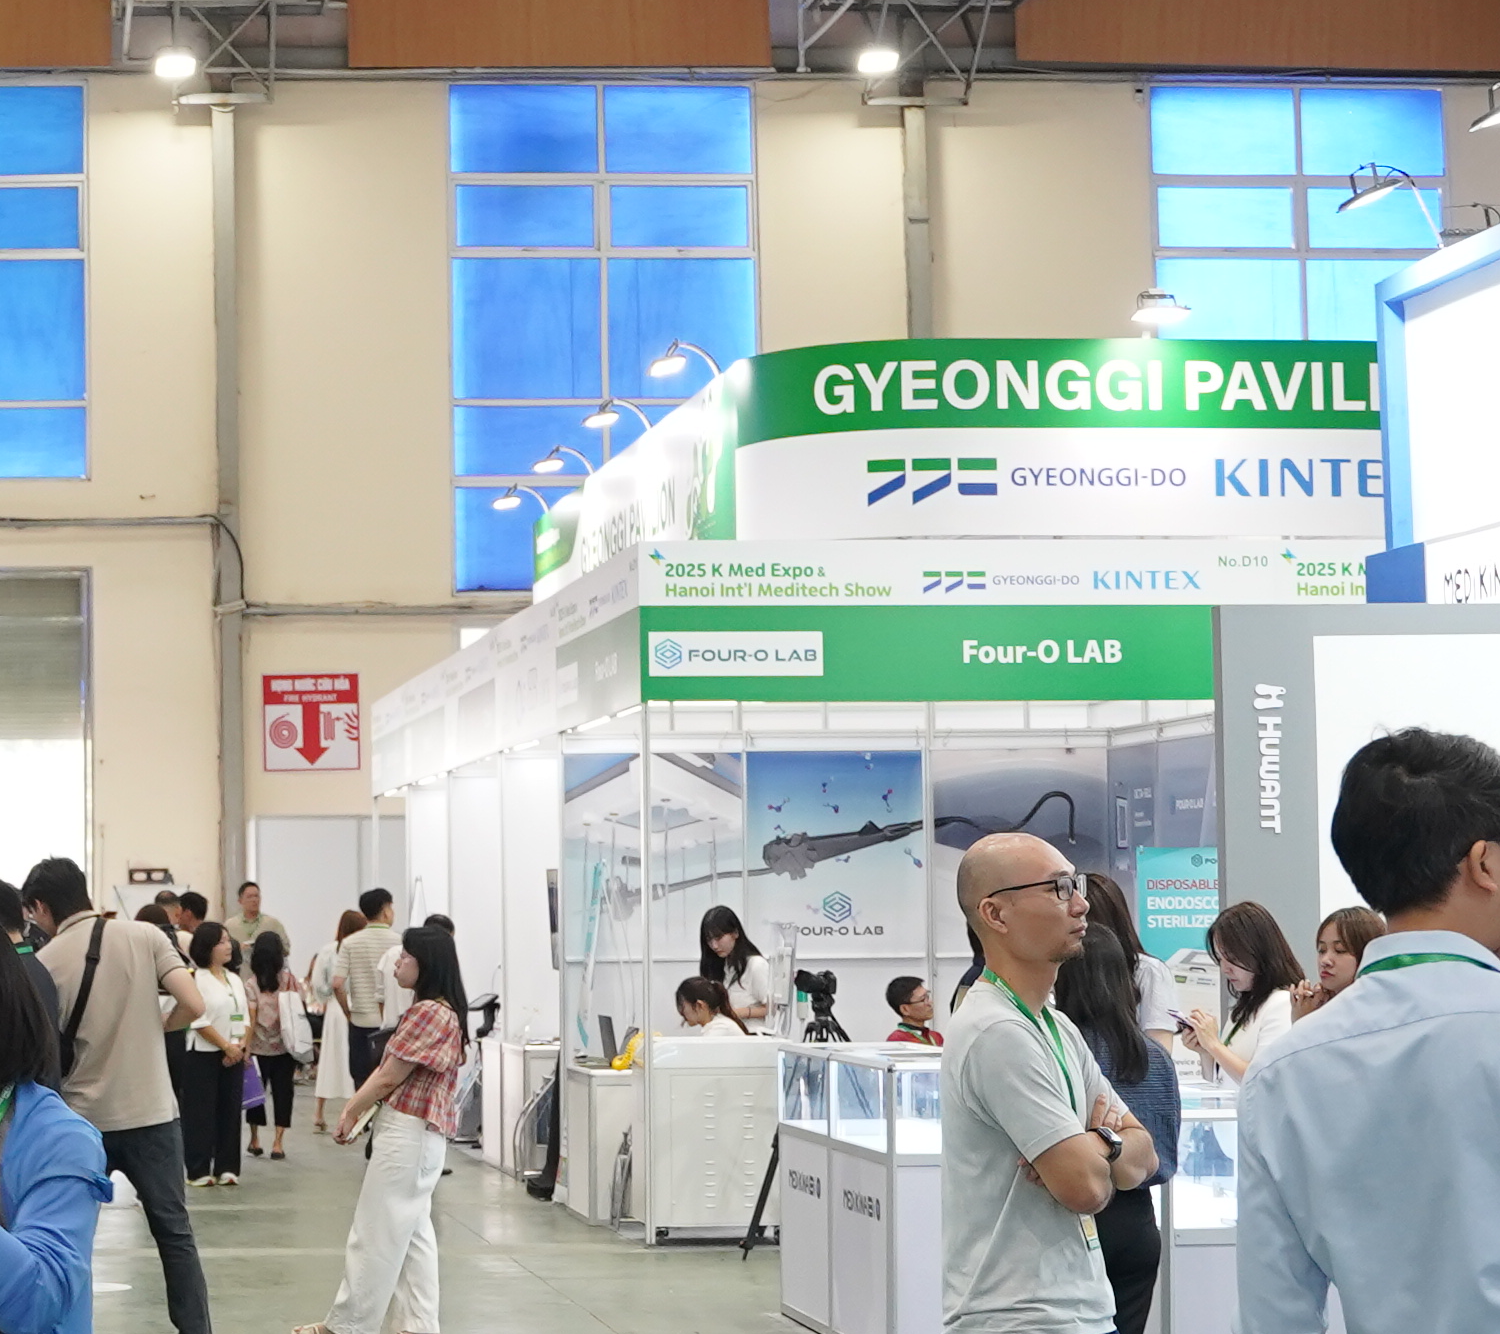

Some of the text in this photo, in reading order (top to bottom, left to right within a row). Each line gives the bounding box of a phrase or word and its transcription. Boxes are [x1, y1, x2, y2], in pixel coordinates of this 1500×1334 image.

[813, 357, 1381, 417] GYEONGGI PAVILI
[1010, 465, 1188, 490] GYEONGGI-DO
[1213, 457, 1385, 499] KINTE
[1218, 556, 1268, 568] No.D10
[665, 563, 814, 582] 2025 K Med Expo
[992, 570, 1200, 591] GYEONGGI-DO KINTEX
[665, 582, 892, 598] Hanoi Int'l Meditech Show
[687, 647, 818, 661] FOUR-O LAB
[962, 638, 1123, 665] Four-O LAB
[1258, 716, 1282, 834] HUWANT
[1146, 878, 1219, 891] DISPOSABLE
[1146, 896, 1219, 910] ENODOSCO
[852, 924, 885, 936] LAB
